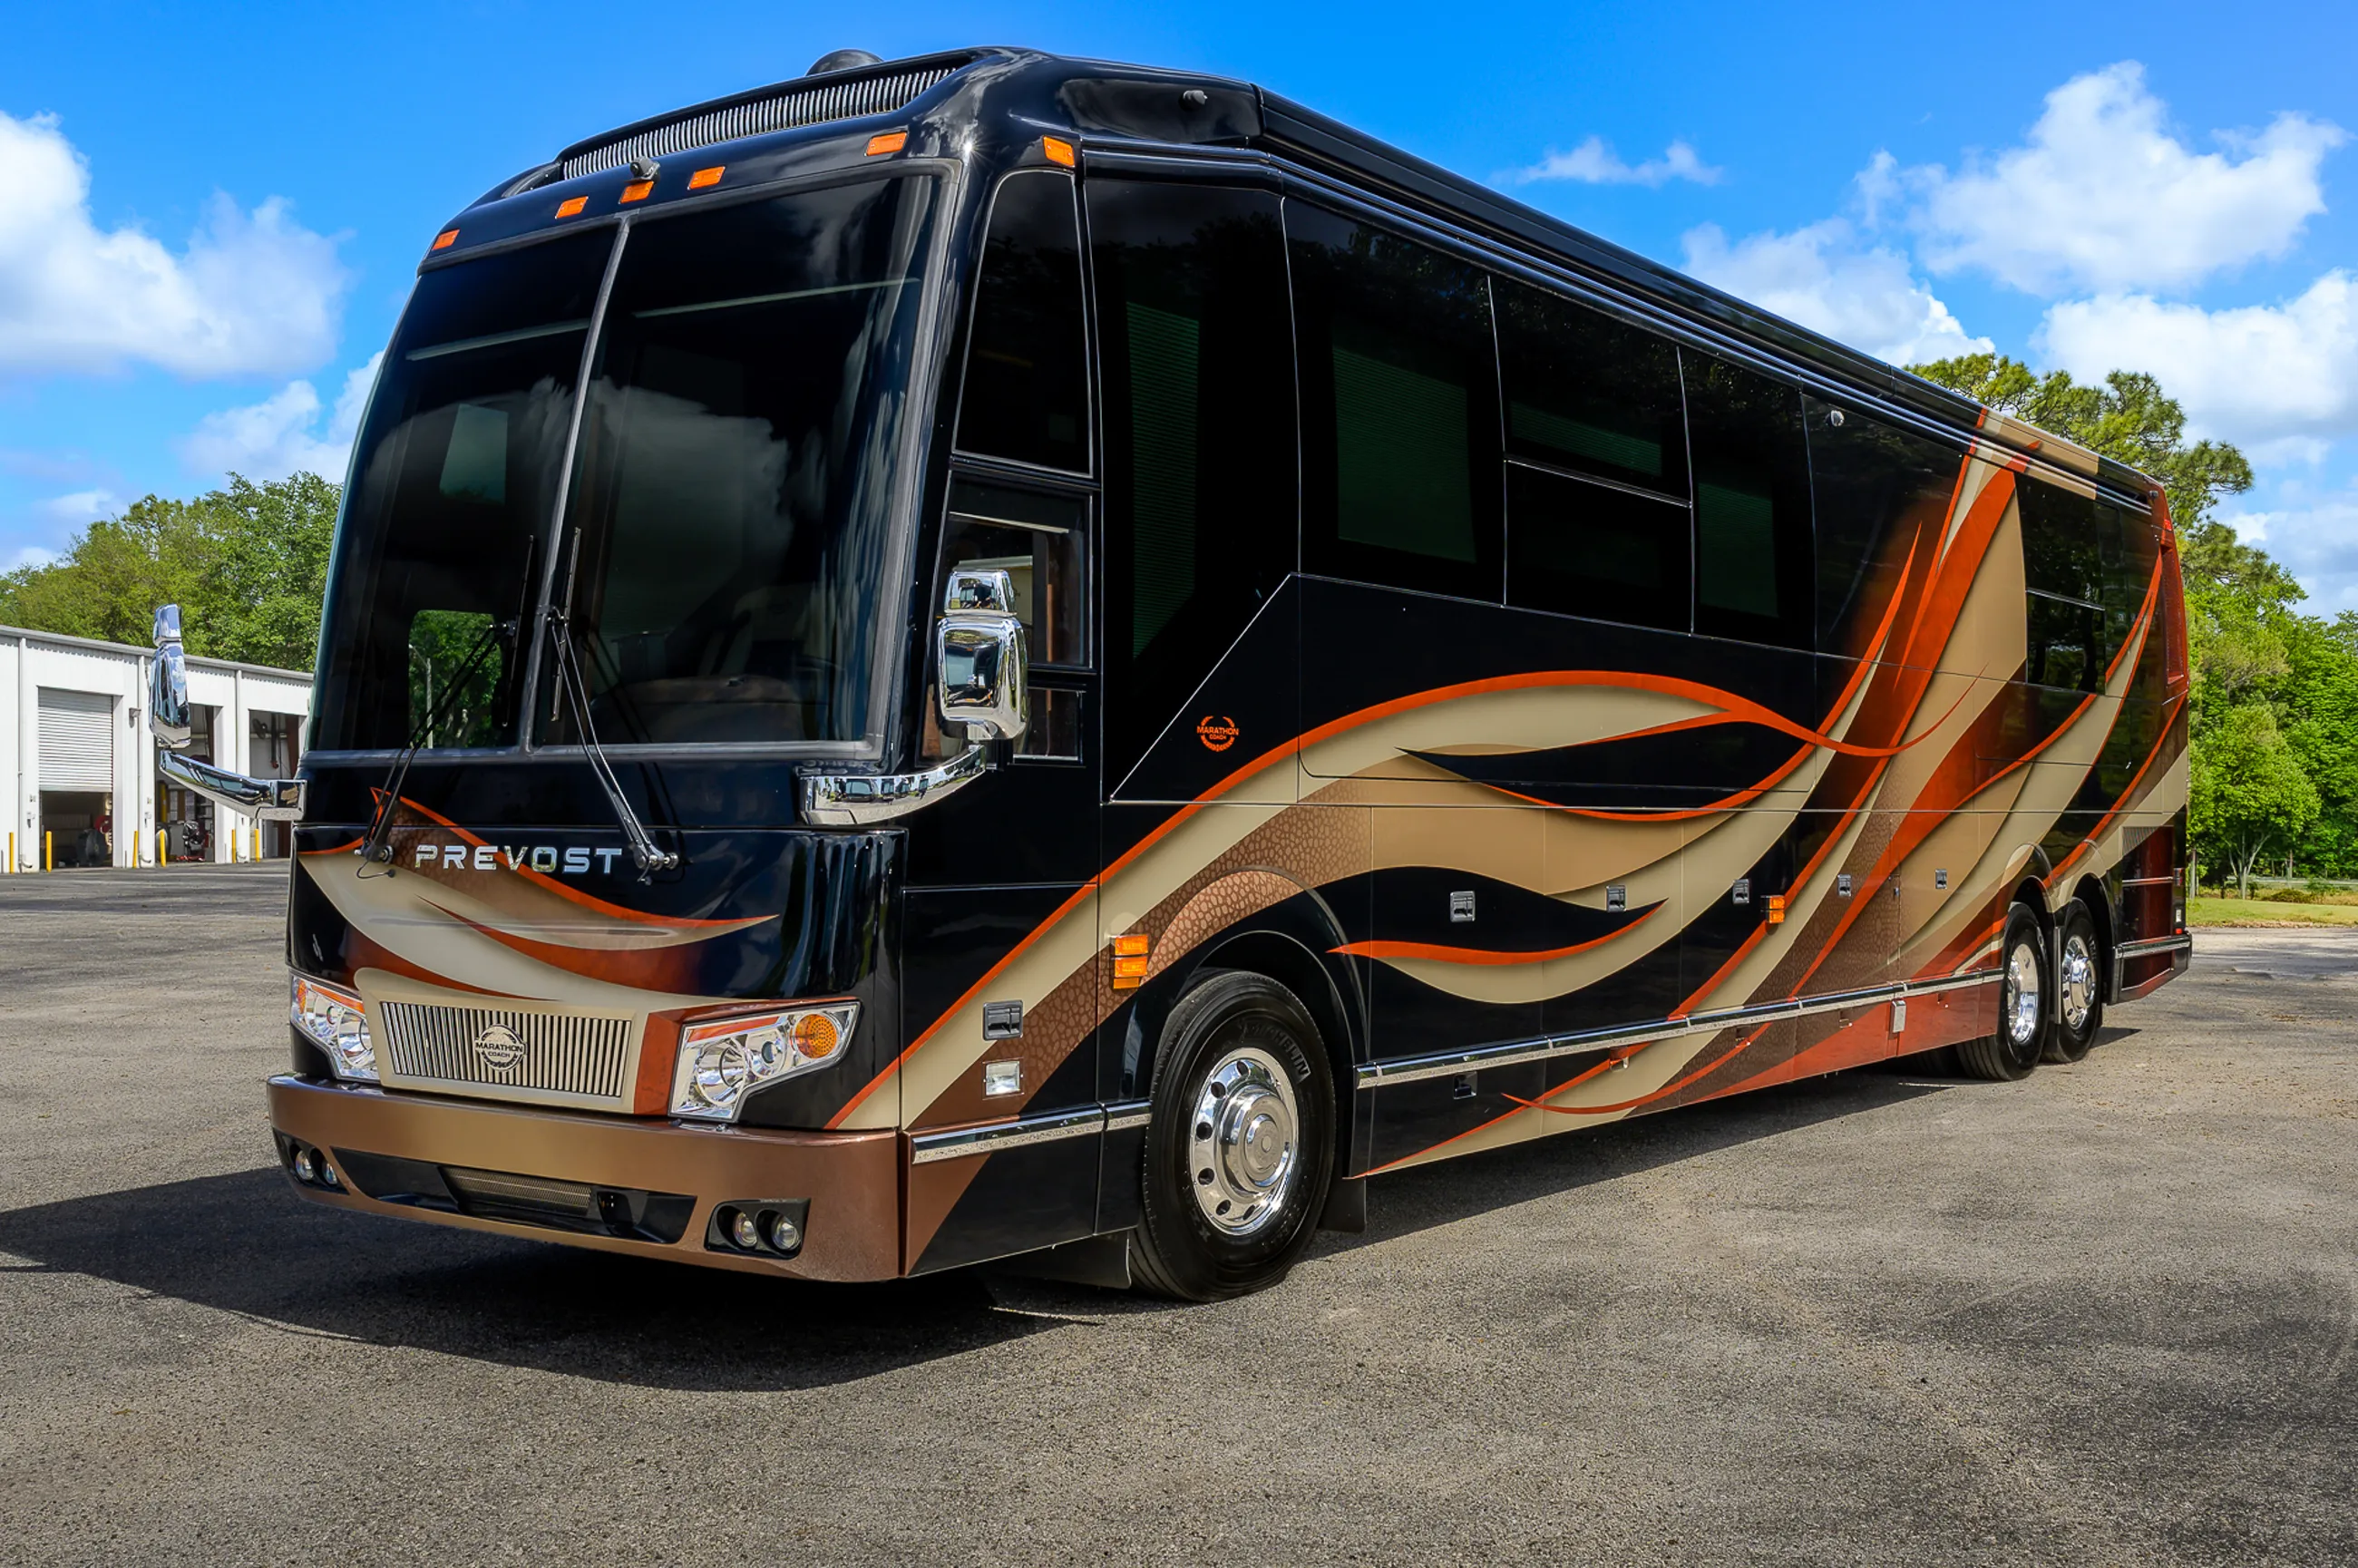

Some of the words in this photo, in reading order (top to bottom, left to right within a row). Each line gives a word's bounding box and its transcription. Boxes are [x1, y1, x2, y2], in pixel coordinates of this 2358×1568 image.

[1196, 726, 1240, 735] MARATHON
[414, 844, 622, 874] PREVOST
[475, 1042, 523, 1052] MARATHON
